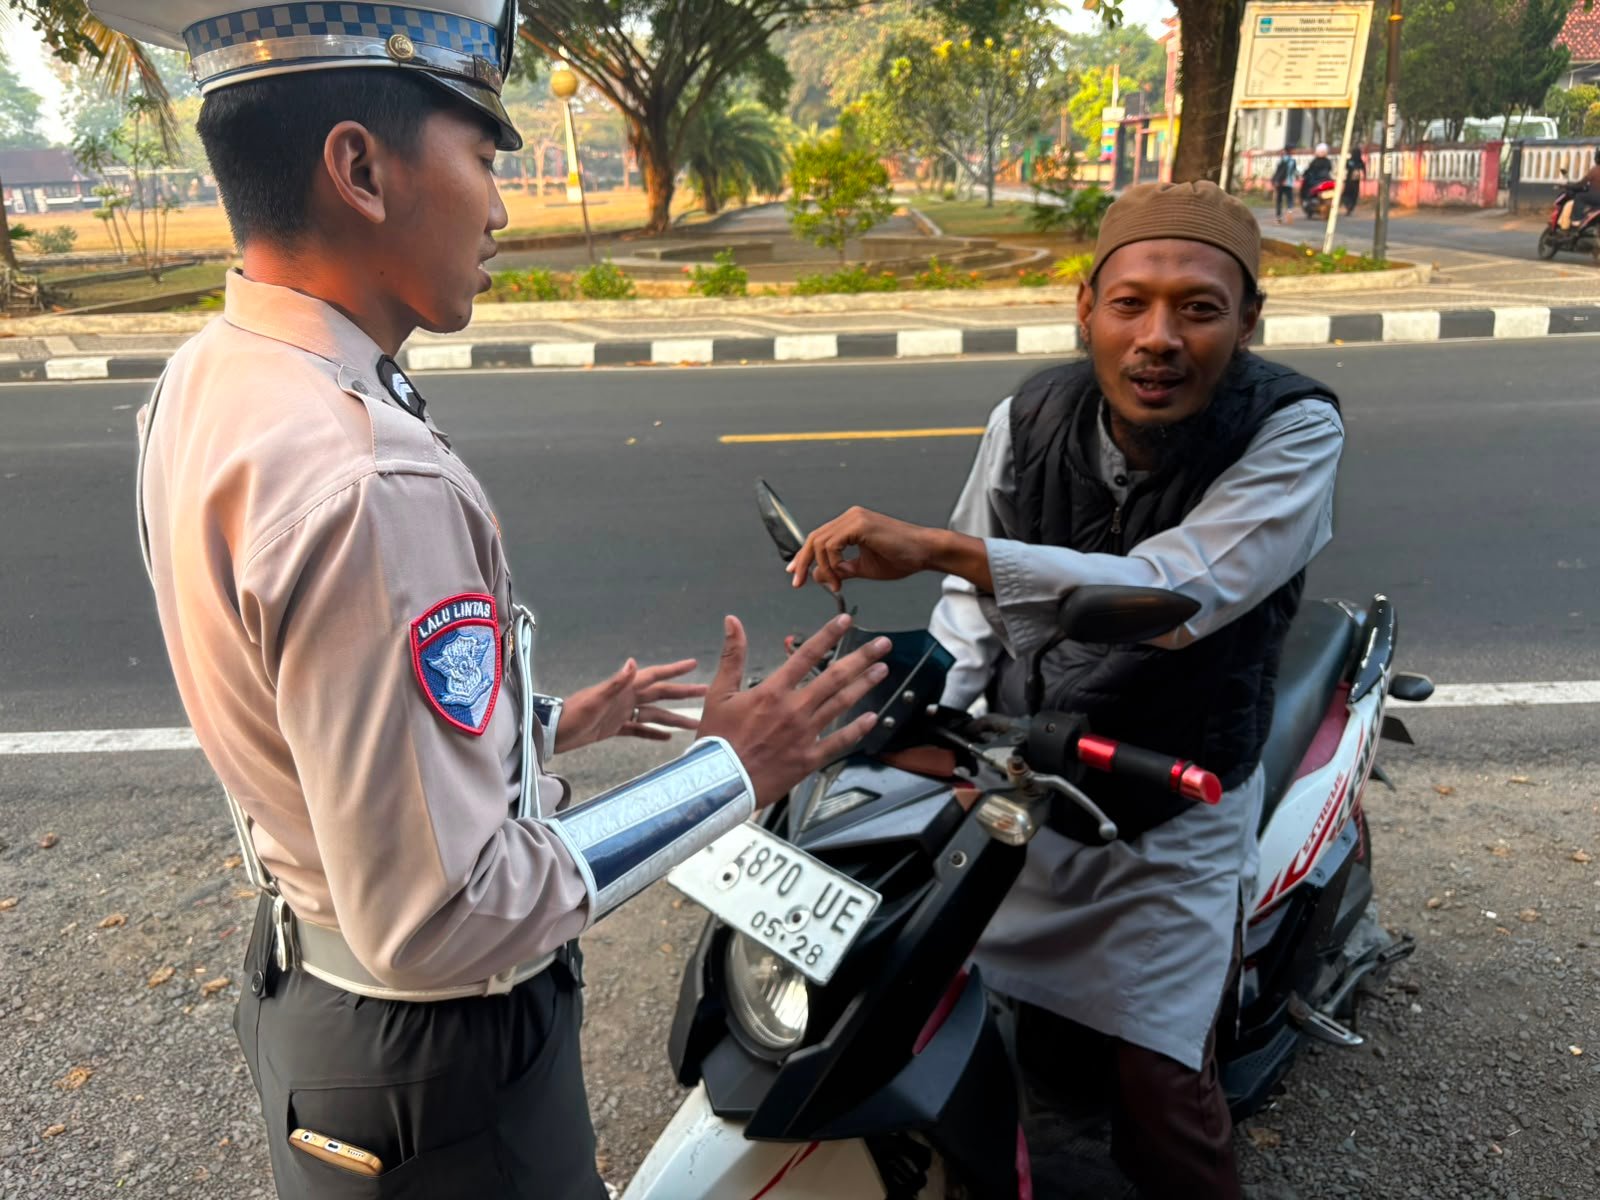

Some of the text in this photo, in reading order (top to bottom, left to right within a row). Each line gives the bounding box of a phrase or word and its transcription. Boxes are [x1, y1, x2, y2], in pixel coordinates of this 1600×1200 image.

[418, 601, 491, 639] LALU LINTAS
[812, 882, 862, 935] UE
